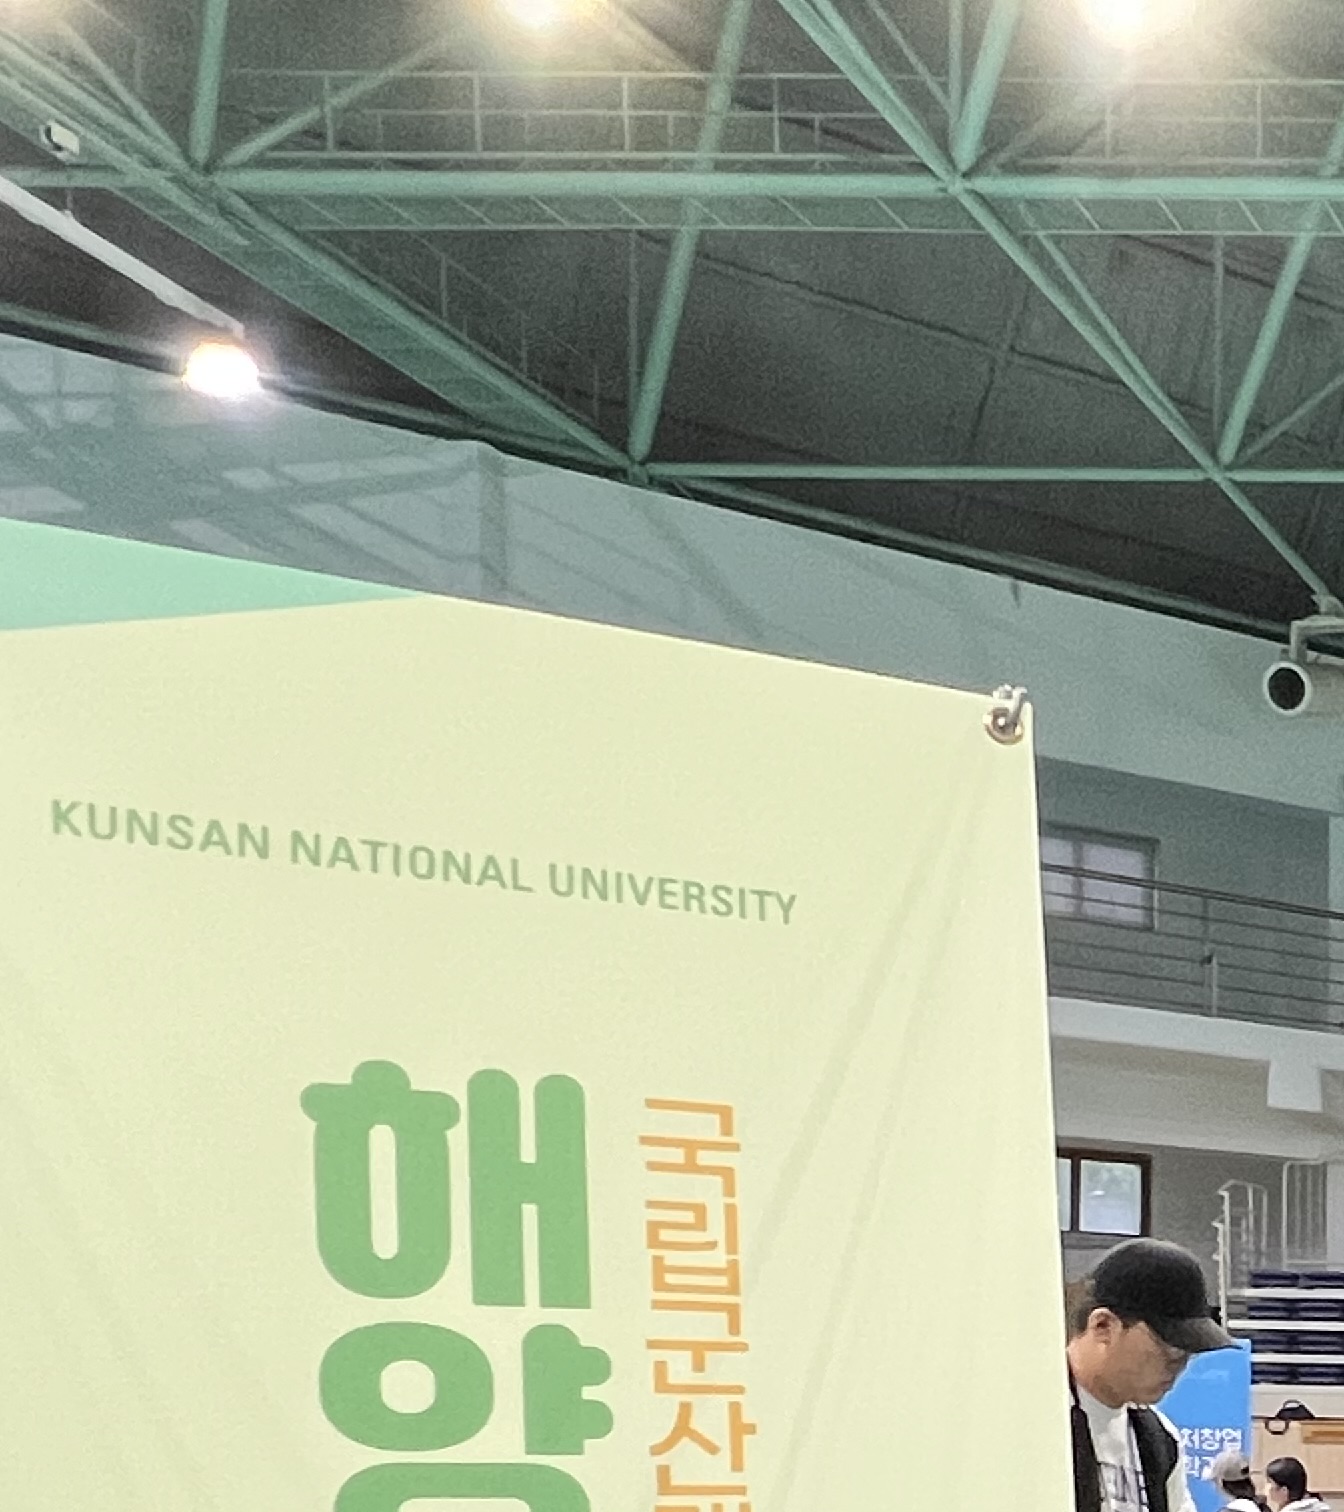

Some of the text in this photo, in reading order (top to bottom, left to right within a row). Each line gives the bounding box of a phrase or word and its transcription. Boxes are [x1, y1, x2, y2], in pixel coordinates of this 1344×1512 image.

[51, 799, 798, 926] KUNSAN NATIONAL UNIVERSITY
